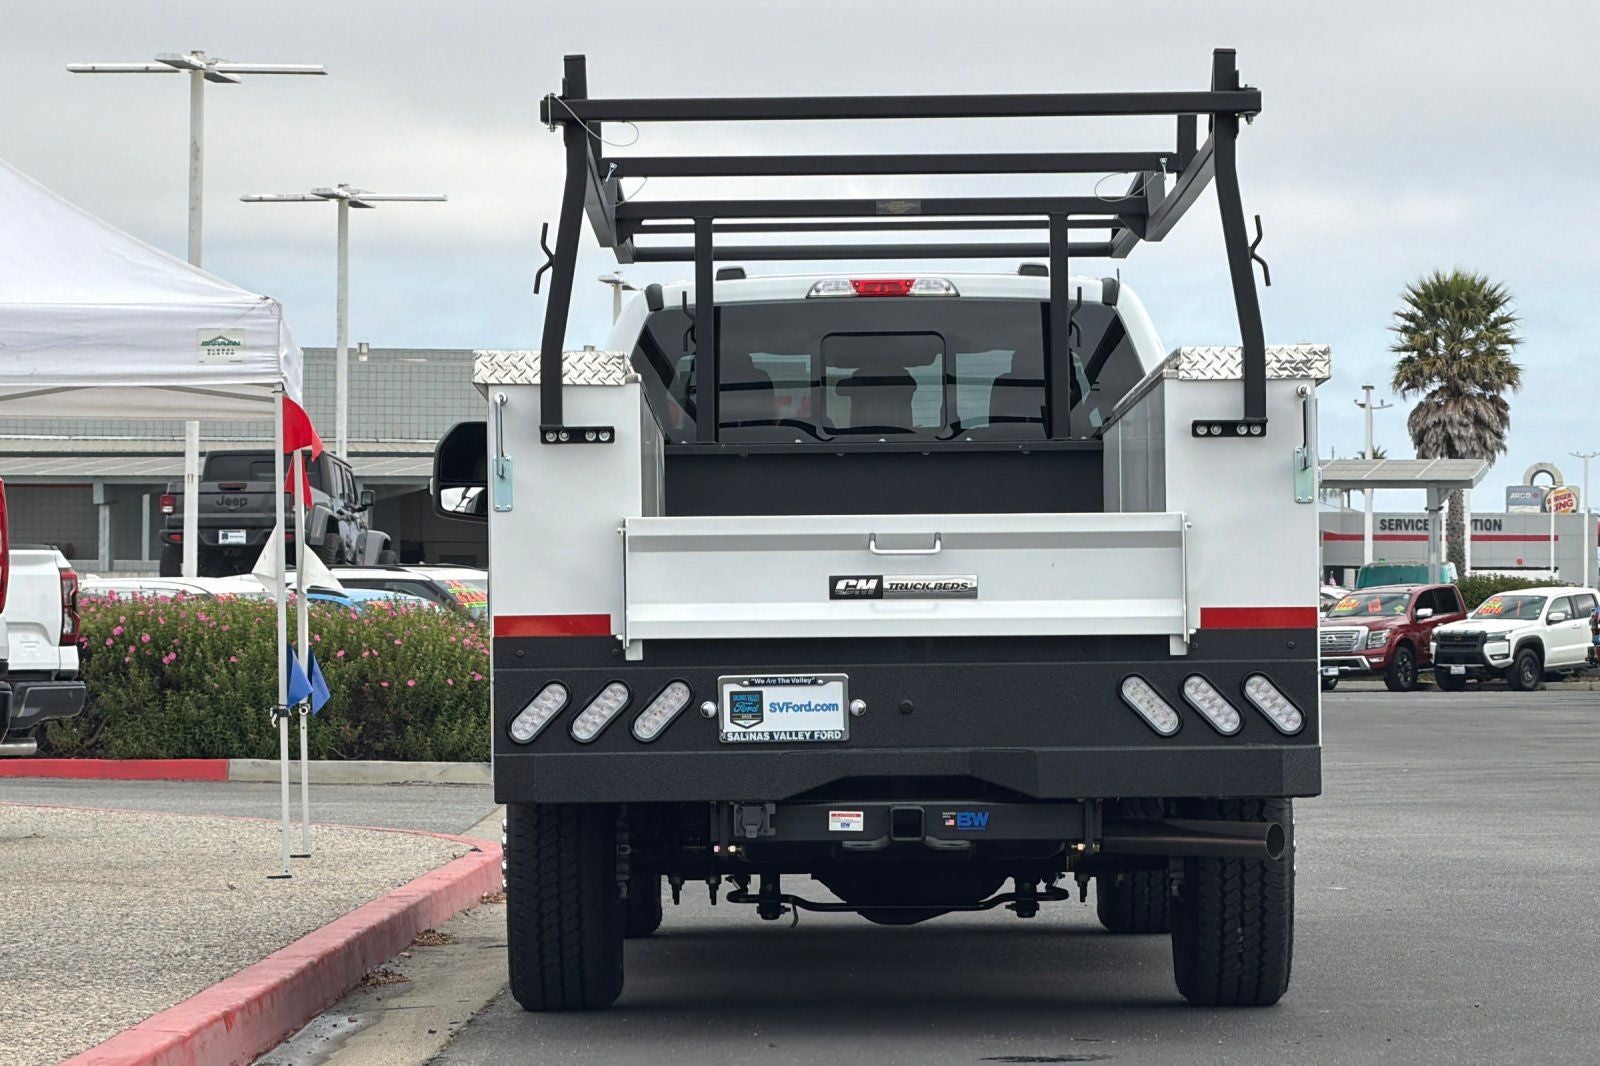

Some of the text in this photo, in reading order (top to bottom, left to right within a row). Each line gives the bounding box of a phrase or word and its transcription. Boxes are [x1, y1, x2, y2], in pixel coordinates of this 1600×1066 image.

[216, 495, 248, 507] Jeep
[1379, 518, 1429, 531] SERVICE
[835, 579, 969, 595] CM TRUCK BEDS
[733, 701, 760, 713] Ford
[769, 700, 839, 714] SVFord.com
[727, 730, 842, 741] SALINAS VALLEY FORD
